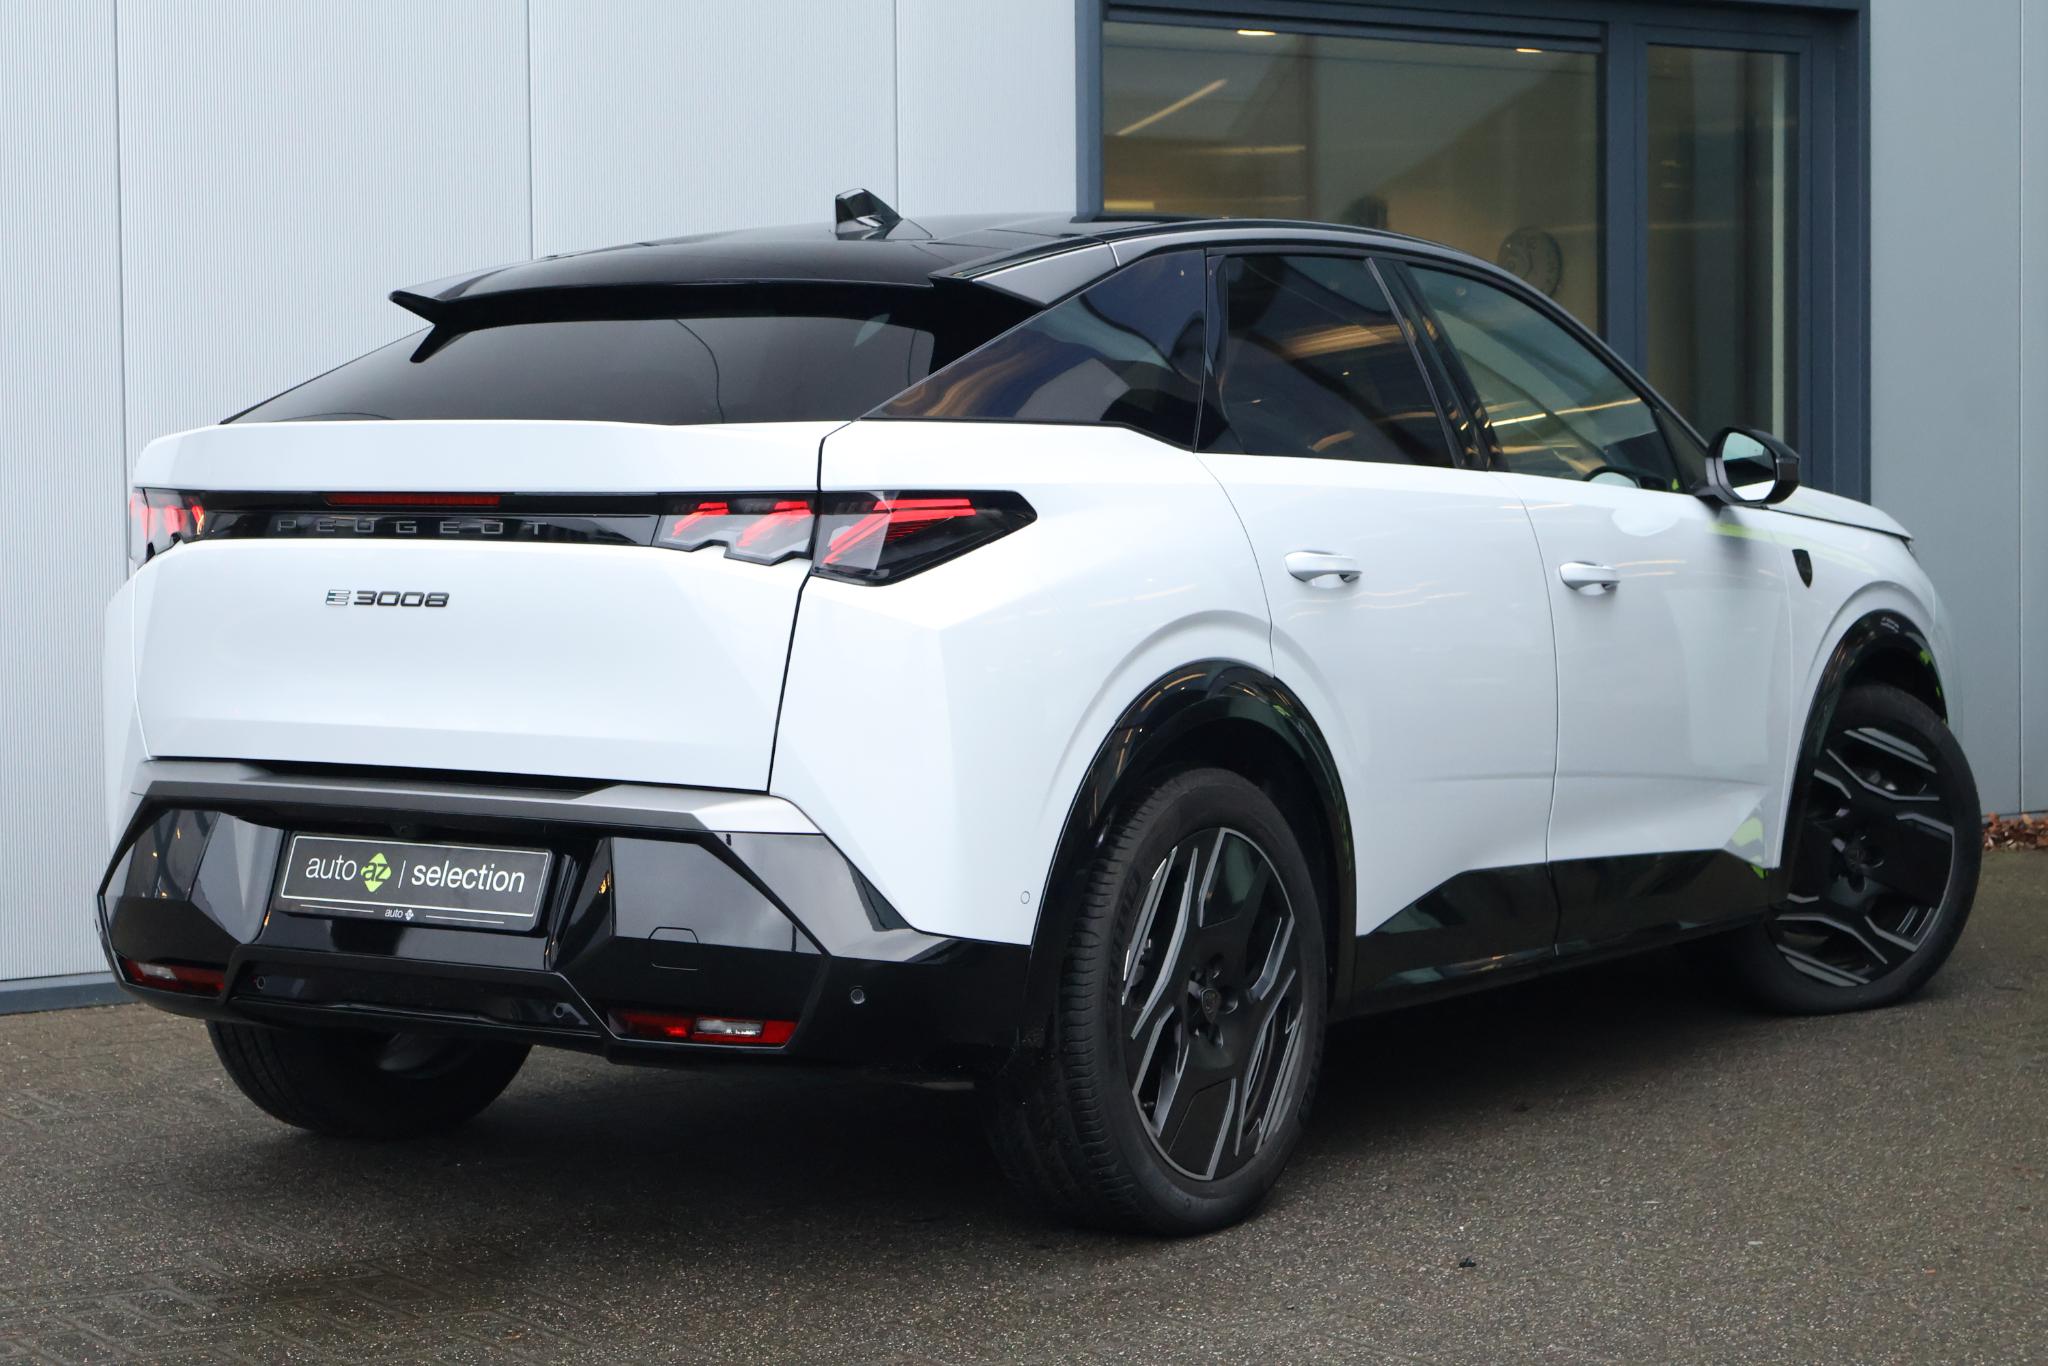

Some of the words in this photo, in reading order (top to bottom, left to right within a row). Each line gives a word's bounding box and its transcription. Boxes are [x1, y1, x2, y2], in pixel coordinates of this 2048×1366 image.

[277, 520, 547, 535] PEUGEOT
[305, 854, 357, 881] auto
[411, 859, 525, 893] selection
[384, 908, 404, 919] auto
